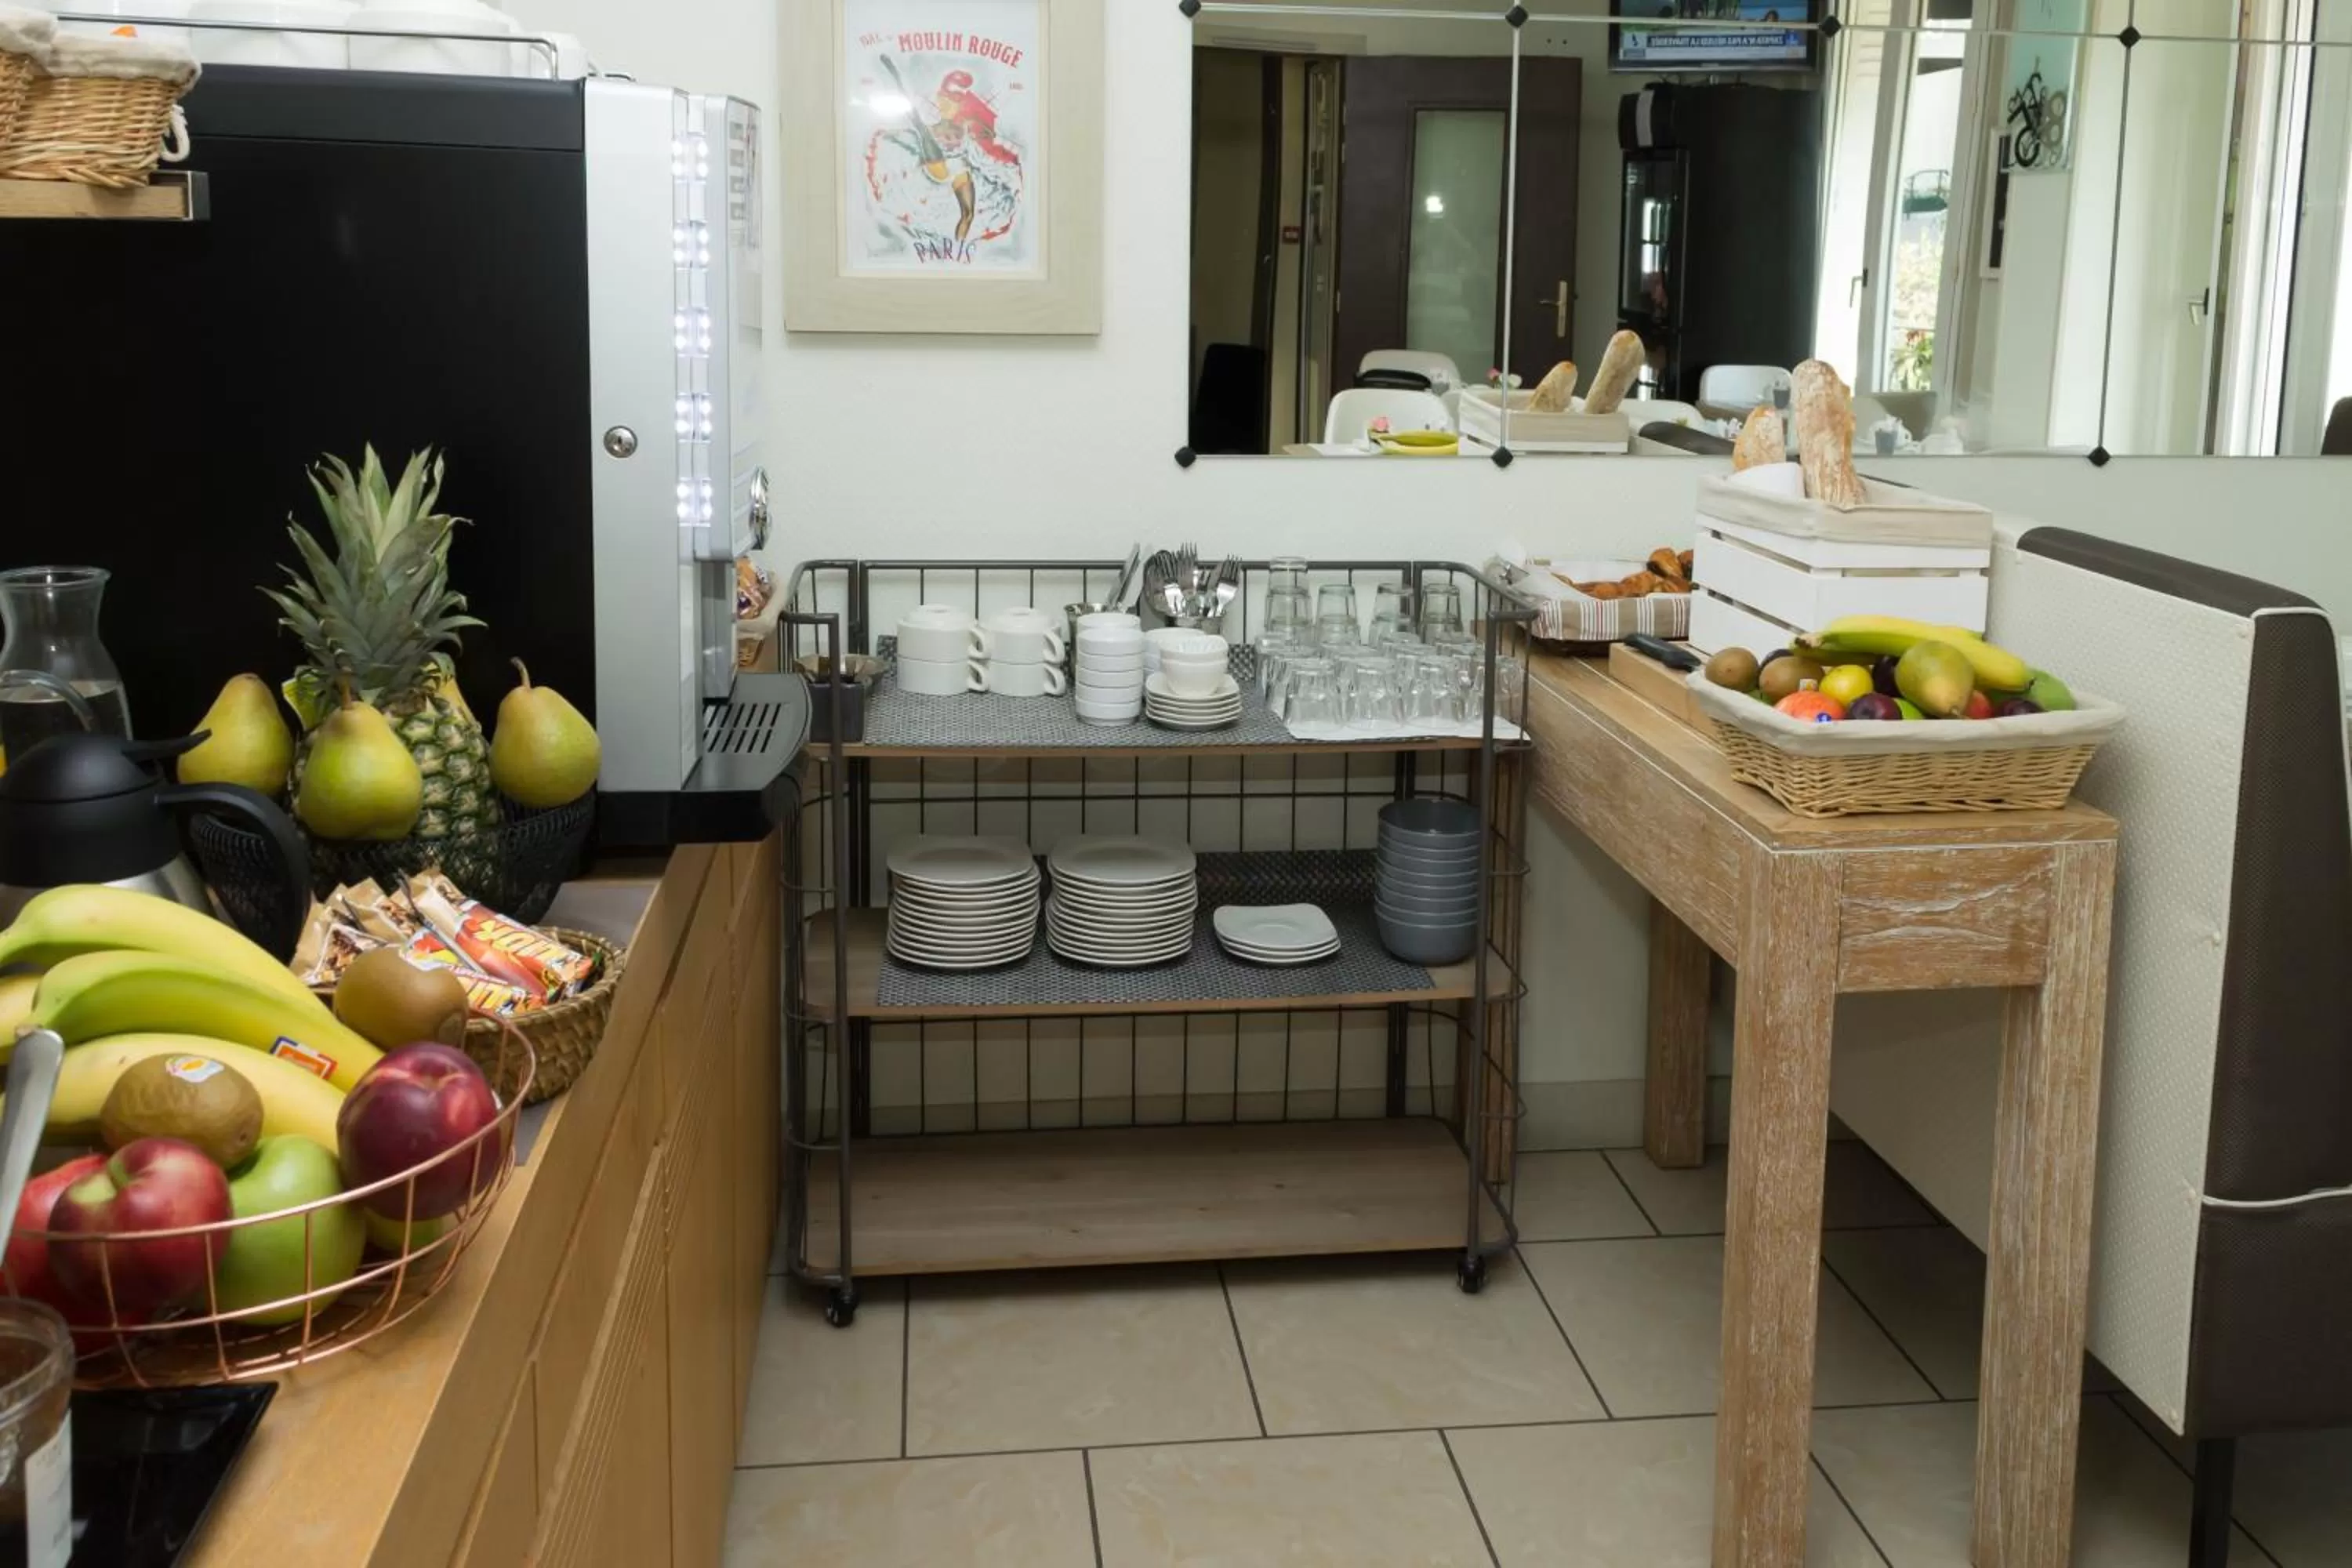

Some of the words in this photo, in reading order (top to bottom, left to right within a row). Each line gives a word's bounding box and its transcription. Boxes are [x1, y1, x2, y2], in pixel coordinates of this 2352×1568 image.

[898, 32, 964, 53] MOULIN
[969, 35, 1024, 68] ROUGE
[913, 238, 976, 264] PARIS
